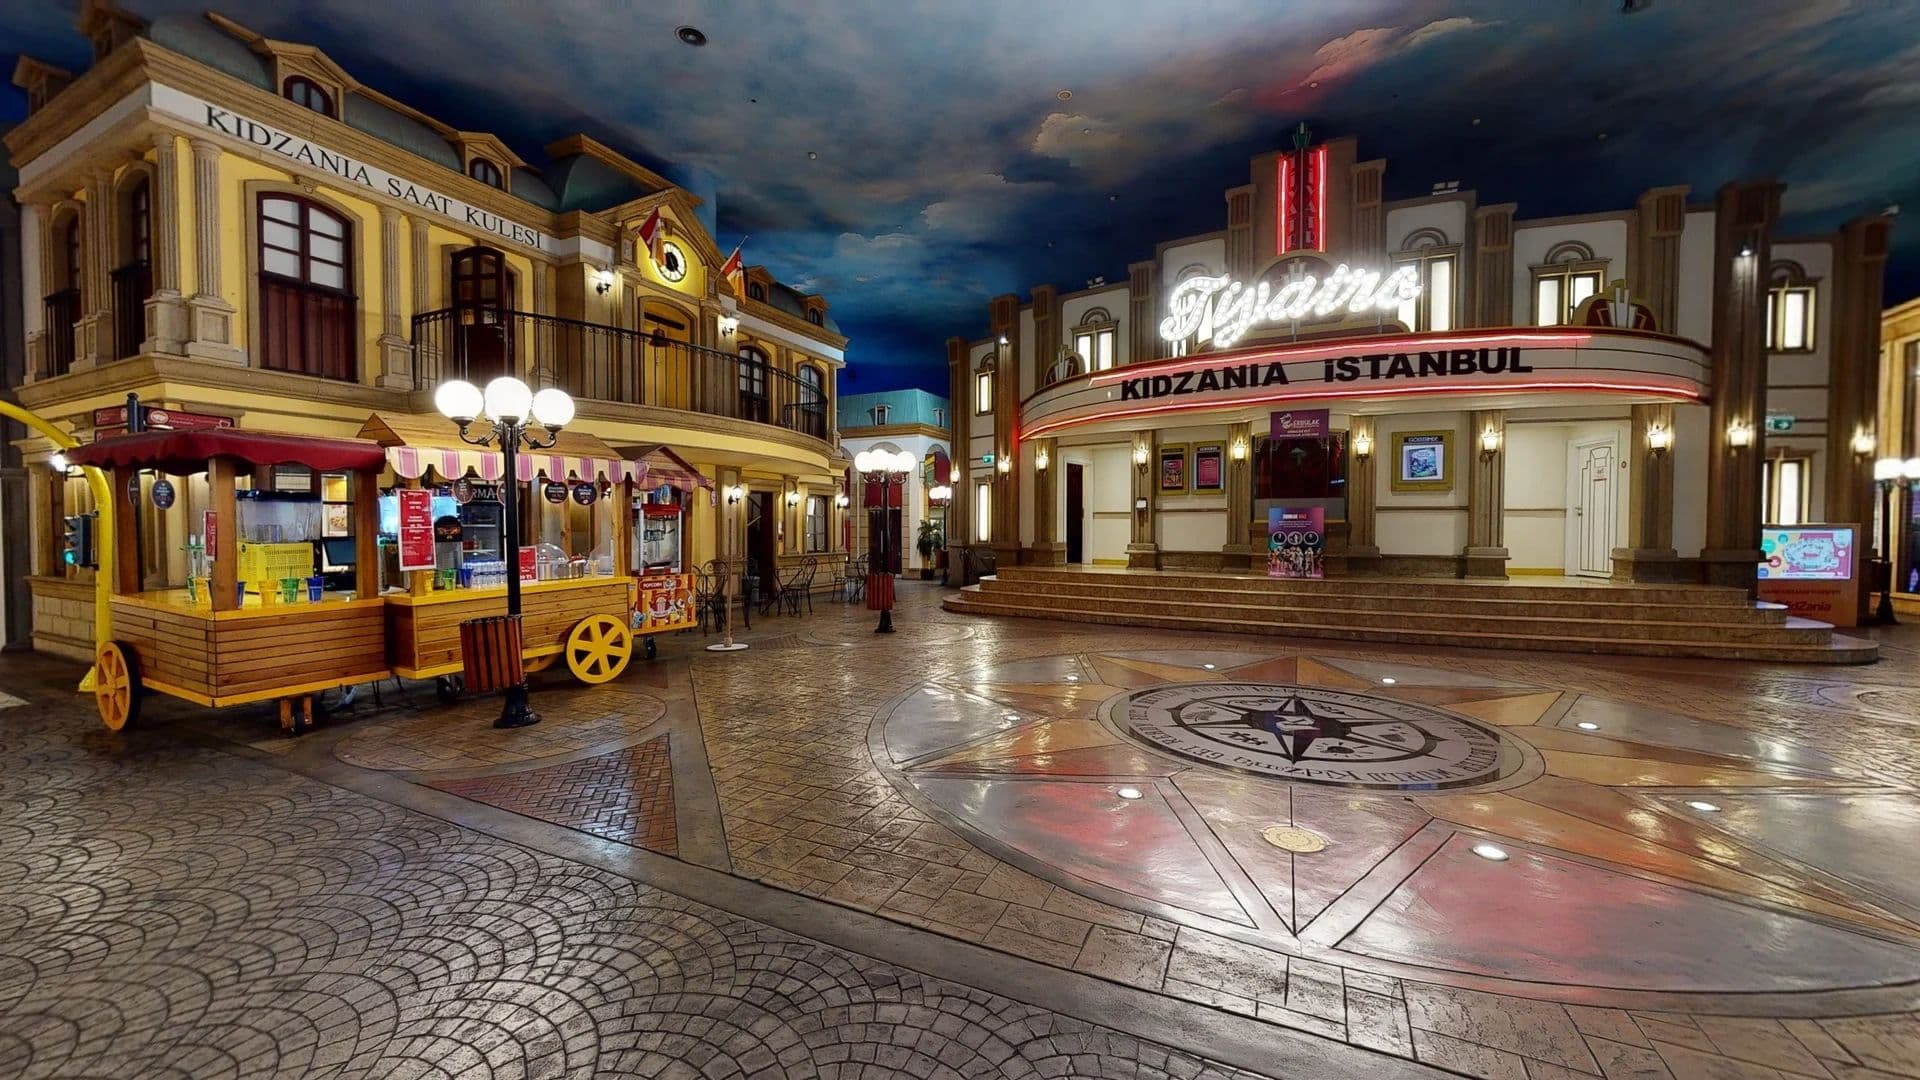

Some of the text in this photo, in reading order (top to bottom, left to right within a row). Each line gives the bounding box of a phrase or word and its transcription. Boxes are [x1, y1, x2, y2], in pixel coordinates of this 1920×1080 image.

[203, 104, 542, 249] KIDZANIA SAAT KULESİ
[1159, 264, 1424, 348] Tiyatro
[1120, 362, 1290, 401] KIDZANIA
[1233, 755, 1363, 781] KidZania
